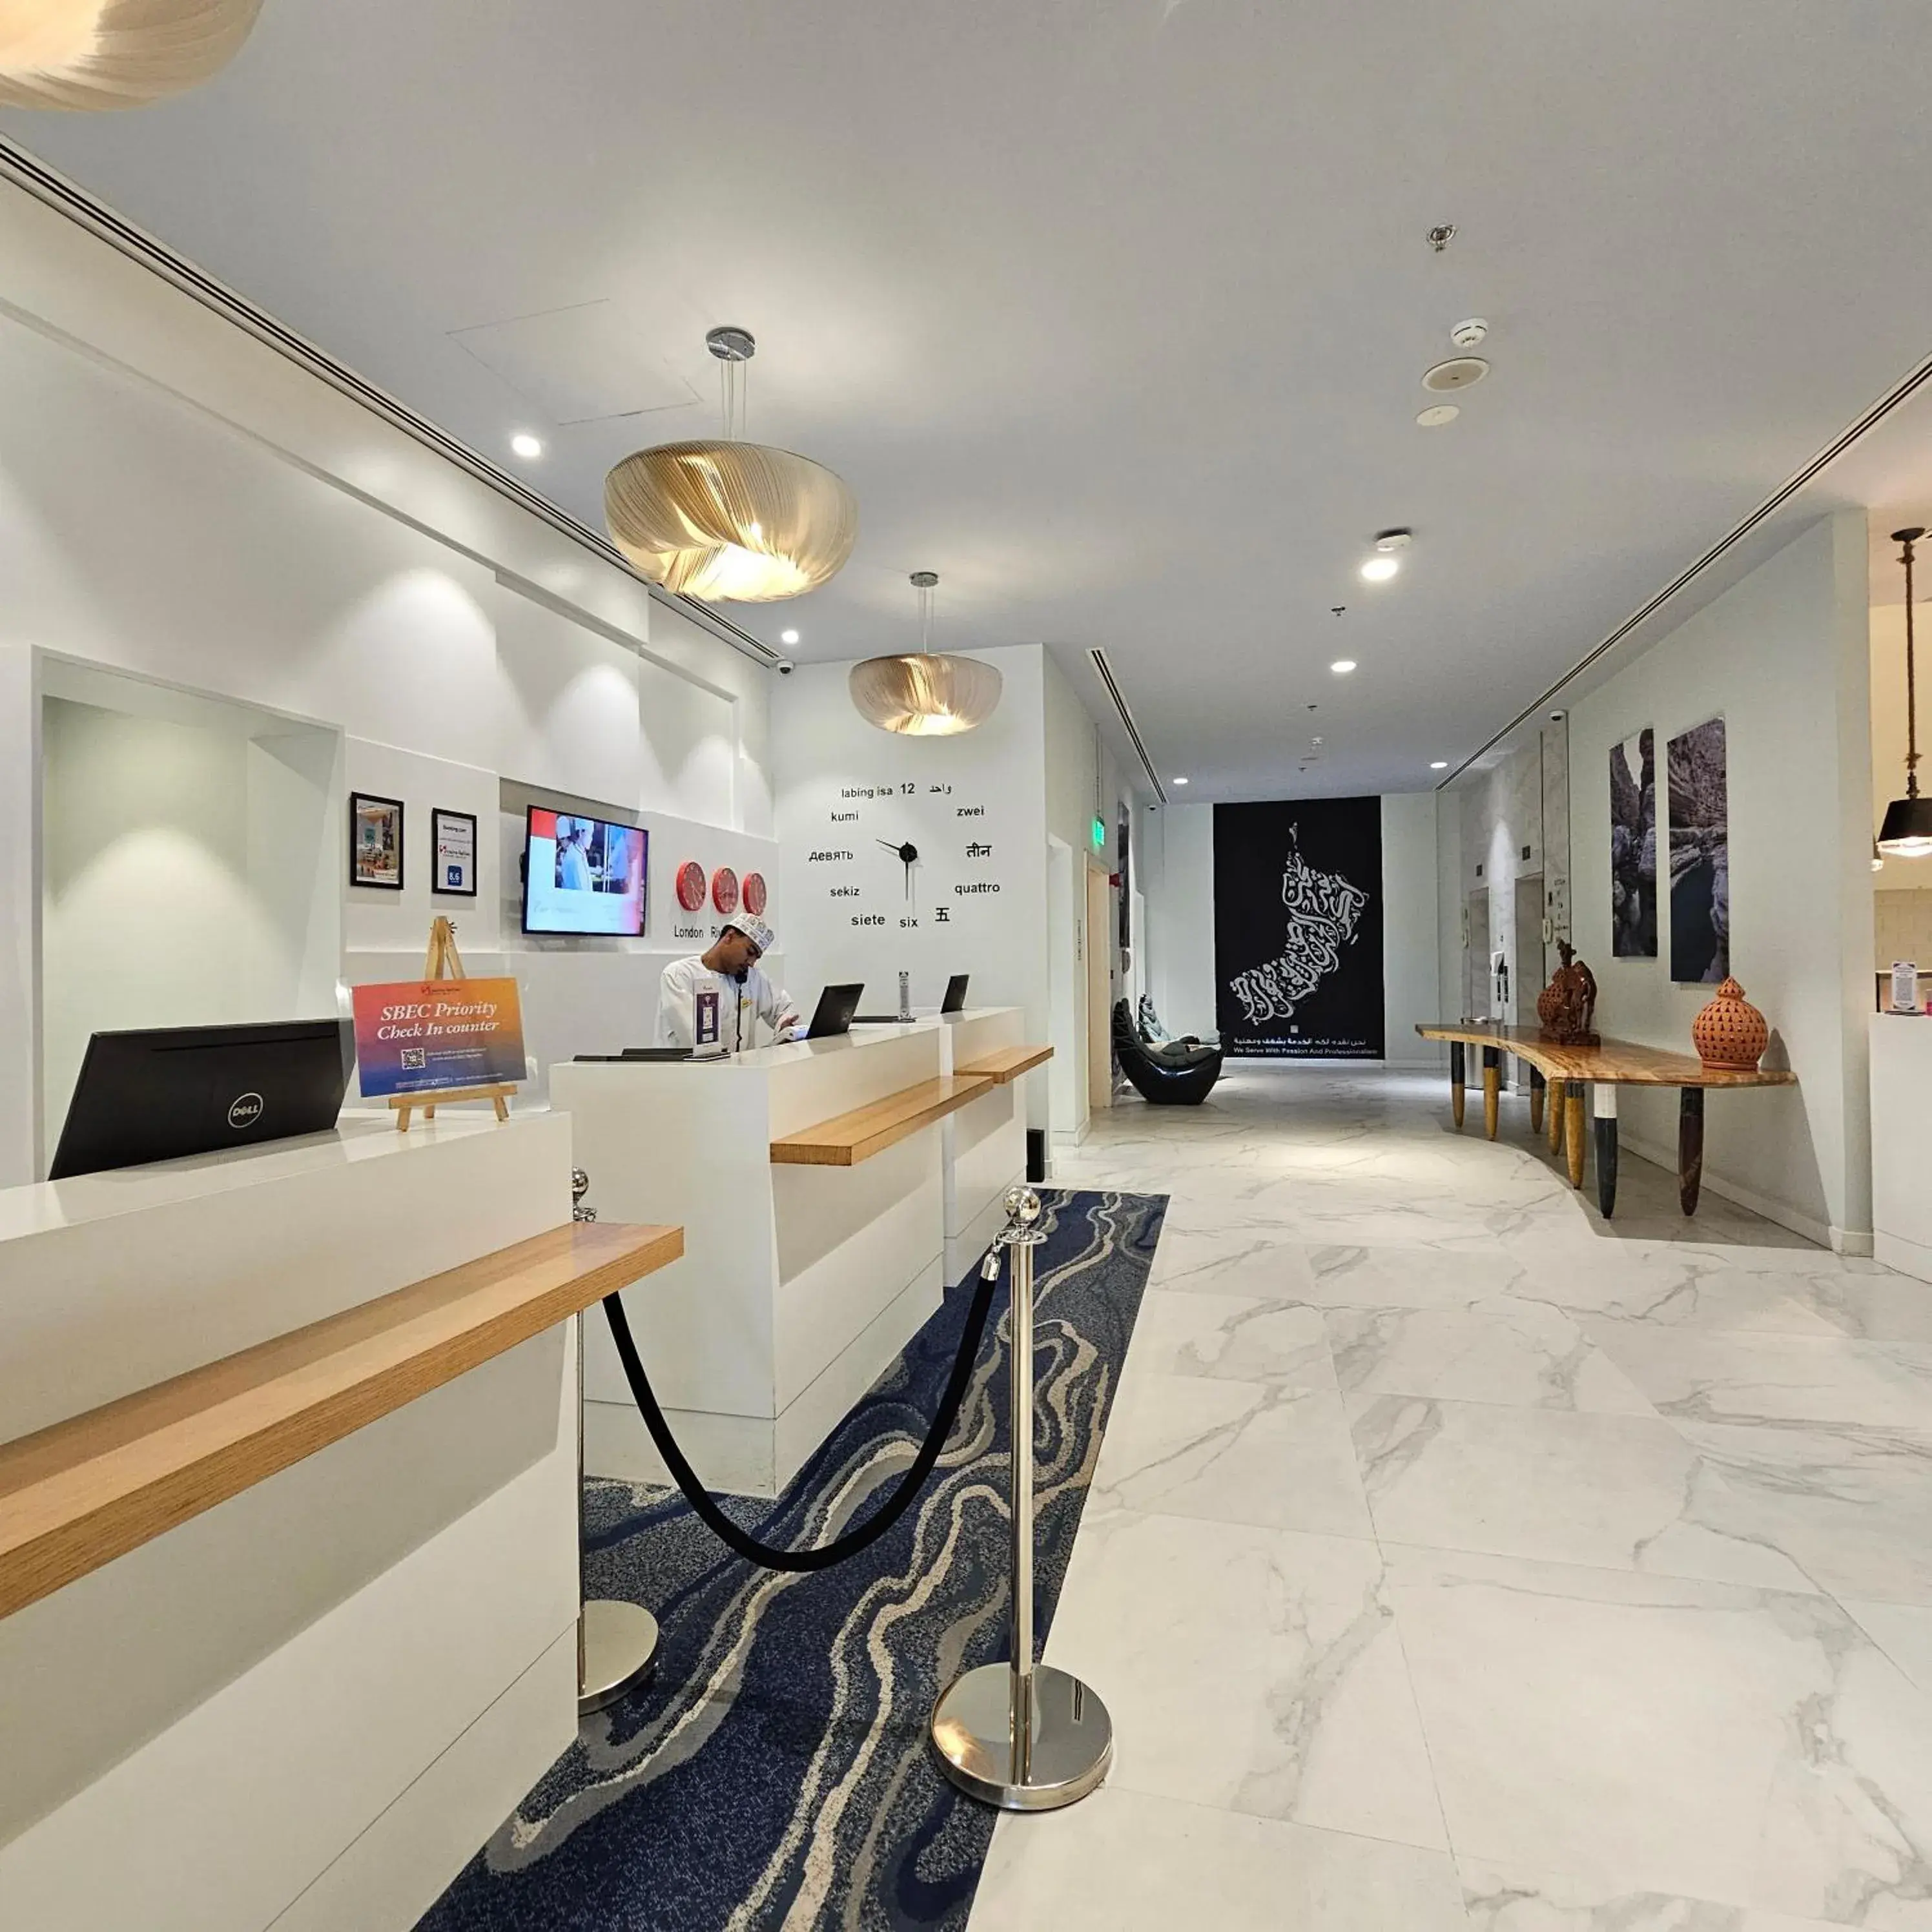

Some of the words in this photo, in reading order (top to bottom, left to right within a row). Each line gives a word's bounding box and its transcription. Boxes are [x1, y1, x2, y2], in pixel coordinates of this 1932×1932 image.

[841, 788, 874, 799] labing
[877, 786, 893, 796] isa
[900, 783, 916, 794] 12
[929, 783, 952, 794] واحد
[830, 811, 859, 822] kumi
[956, 805, 985, 817] zwei
[965, 841, 992, 858] तीन
[808, 850, 854, 862] девять
[830, 885, 860, 897] sekiz
[954, 882, 1000, 896] quattro
[850, 914, 886, 926] siete
[934, 907, 951, 922] 五
[899, 916, 918, 928] six
[674, 925, 704, 938] London
[380, 1003, 431, 1021] SBEC
[435, 1002, 497, 1018] Priority
[377, 1023, 422, 1040] Check
[426, 1022, 443, 1036] In
[446, 1020, 500, 1034] counter
[232, 1104, 258, 1117] DELL
